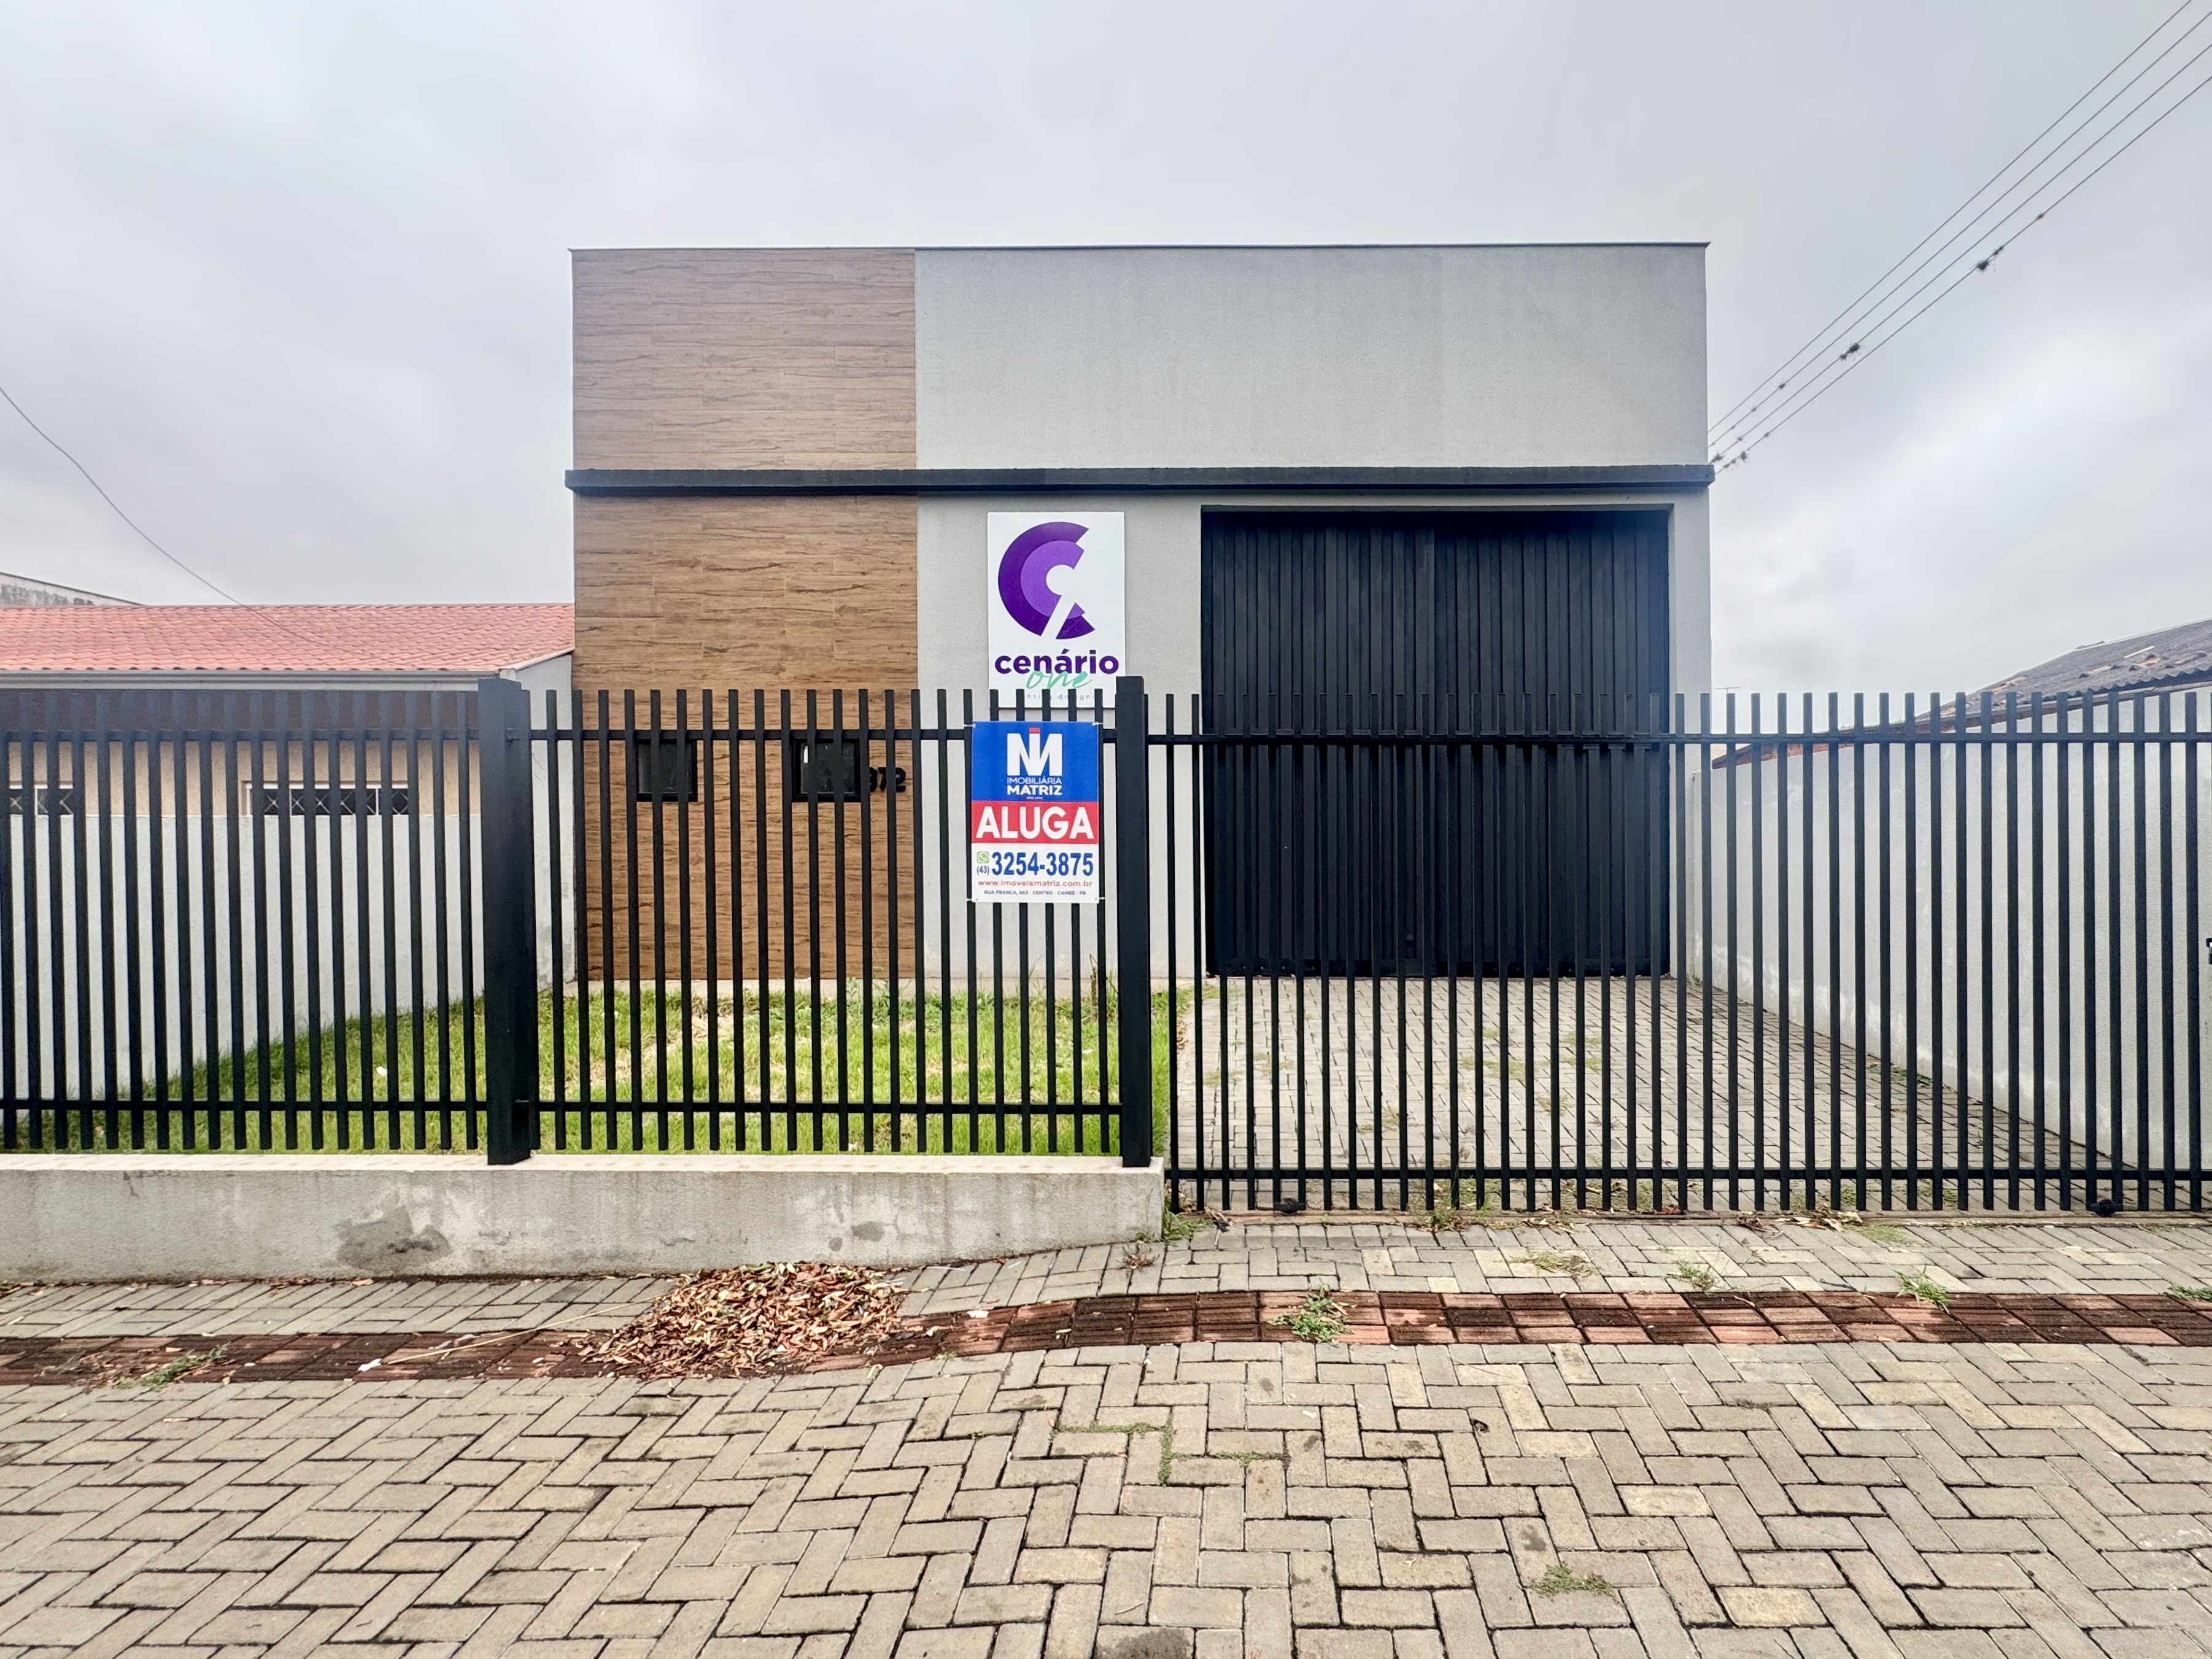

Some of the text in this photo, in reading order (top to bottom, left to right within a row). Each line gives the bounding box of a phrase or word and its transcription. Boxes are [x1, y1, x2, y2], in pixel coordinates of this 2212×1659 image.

[994, 648, 1120, 675] cenário
[1026, 670, 1093, 690] one
[1007, 776, 1062, 785] IMOBILIÁRIA
[1007, 784, 1062, 796] MATRIZ
[975, 805, 1095, 840] ALUGA
[976, 851, 1094, 876] (43) 3254-3875
